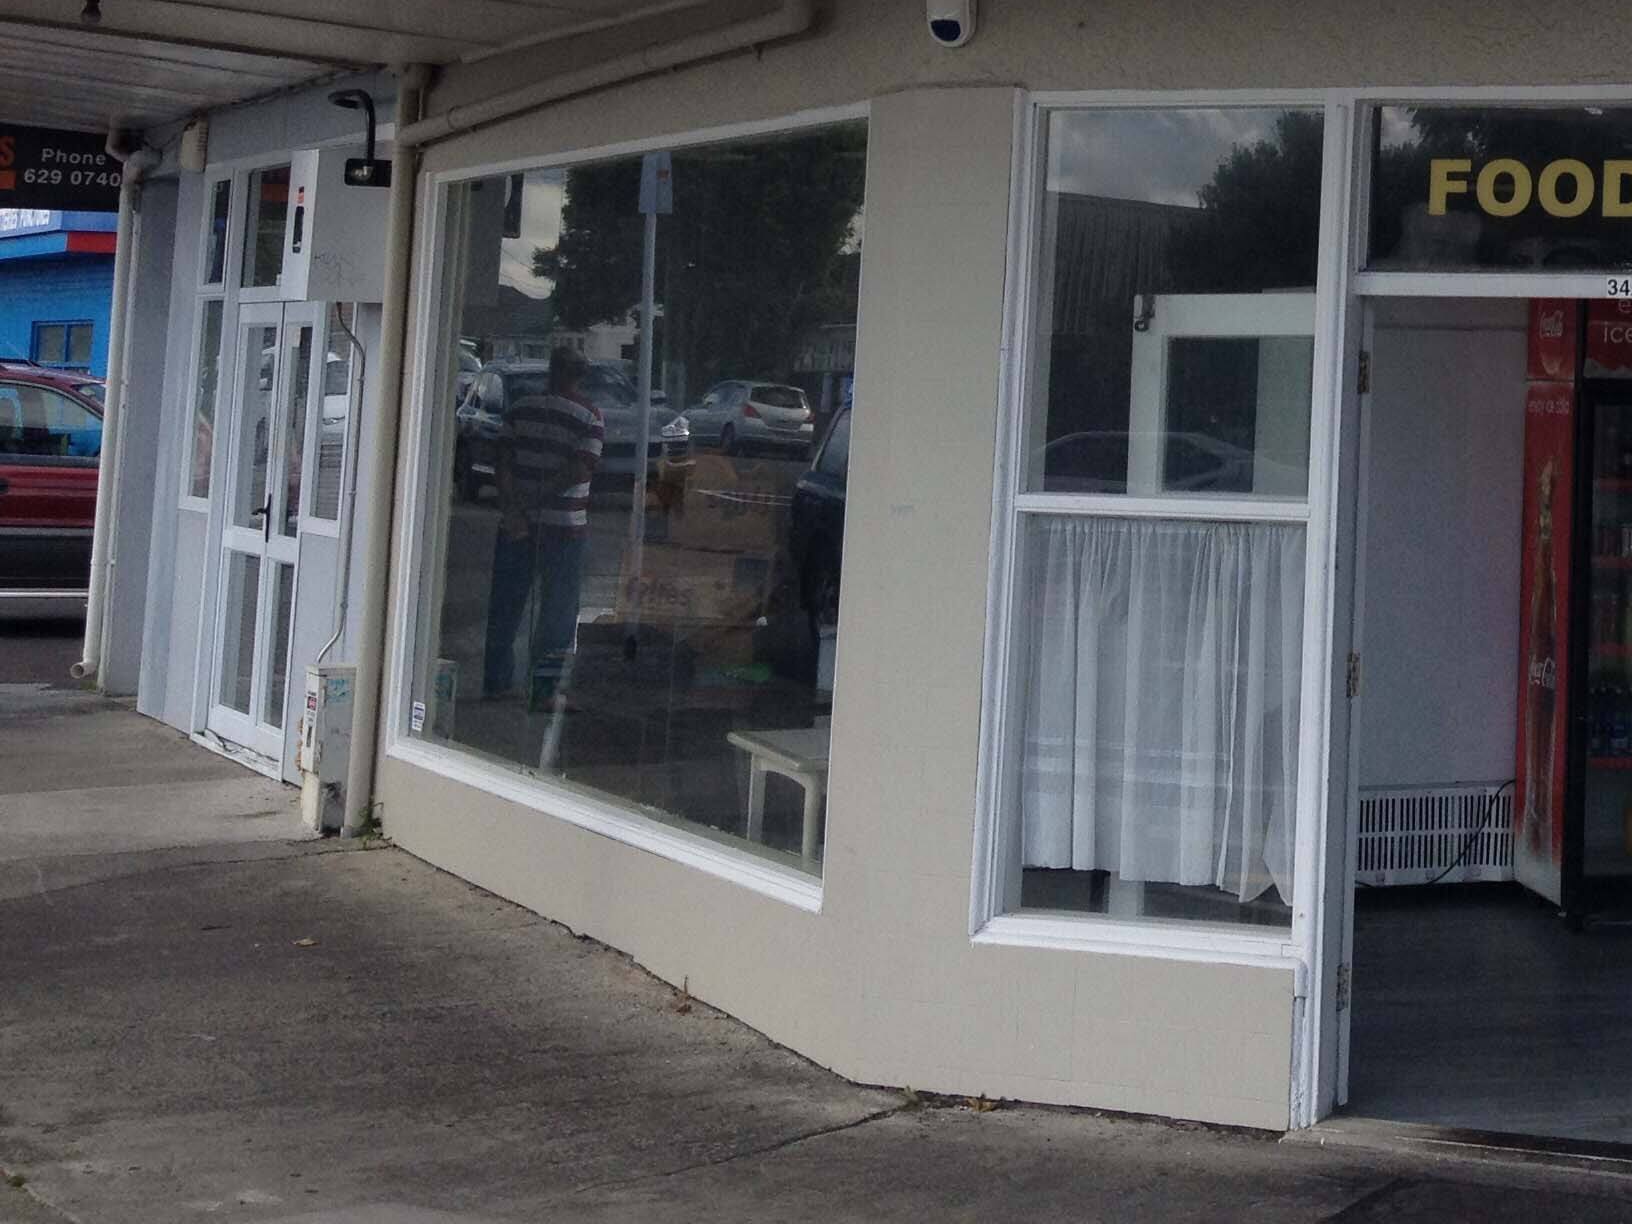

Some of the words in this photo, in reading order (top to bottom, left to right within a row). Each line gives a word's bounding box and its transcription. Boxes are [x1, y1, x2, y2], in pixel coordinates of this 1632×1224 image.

[40, 147, 107, 166] Phone
[23, 168, 63, 185] 629
[69, 169, 121, 187] 0740
